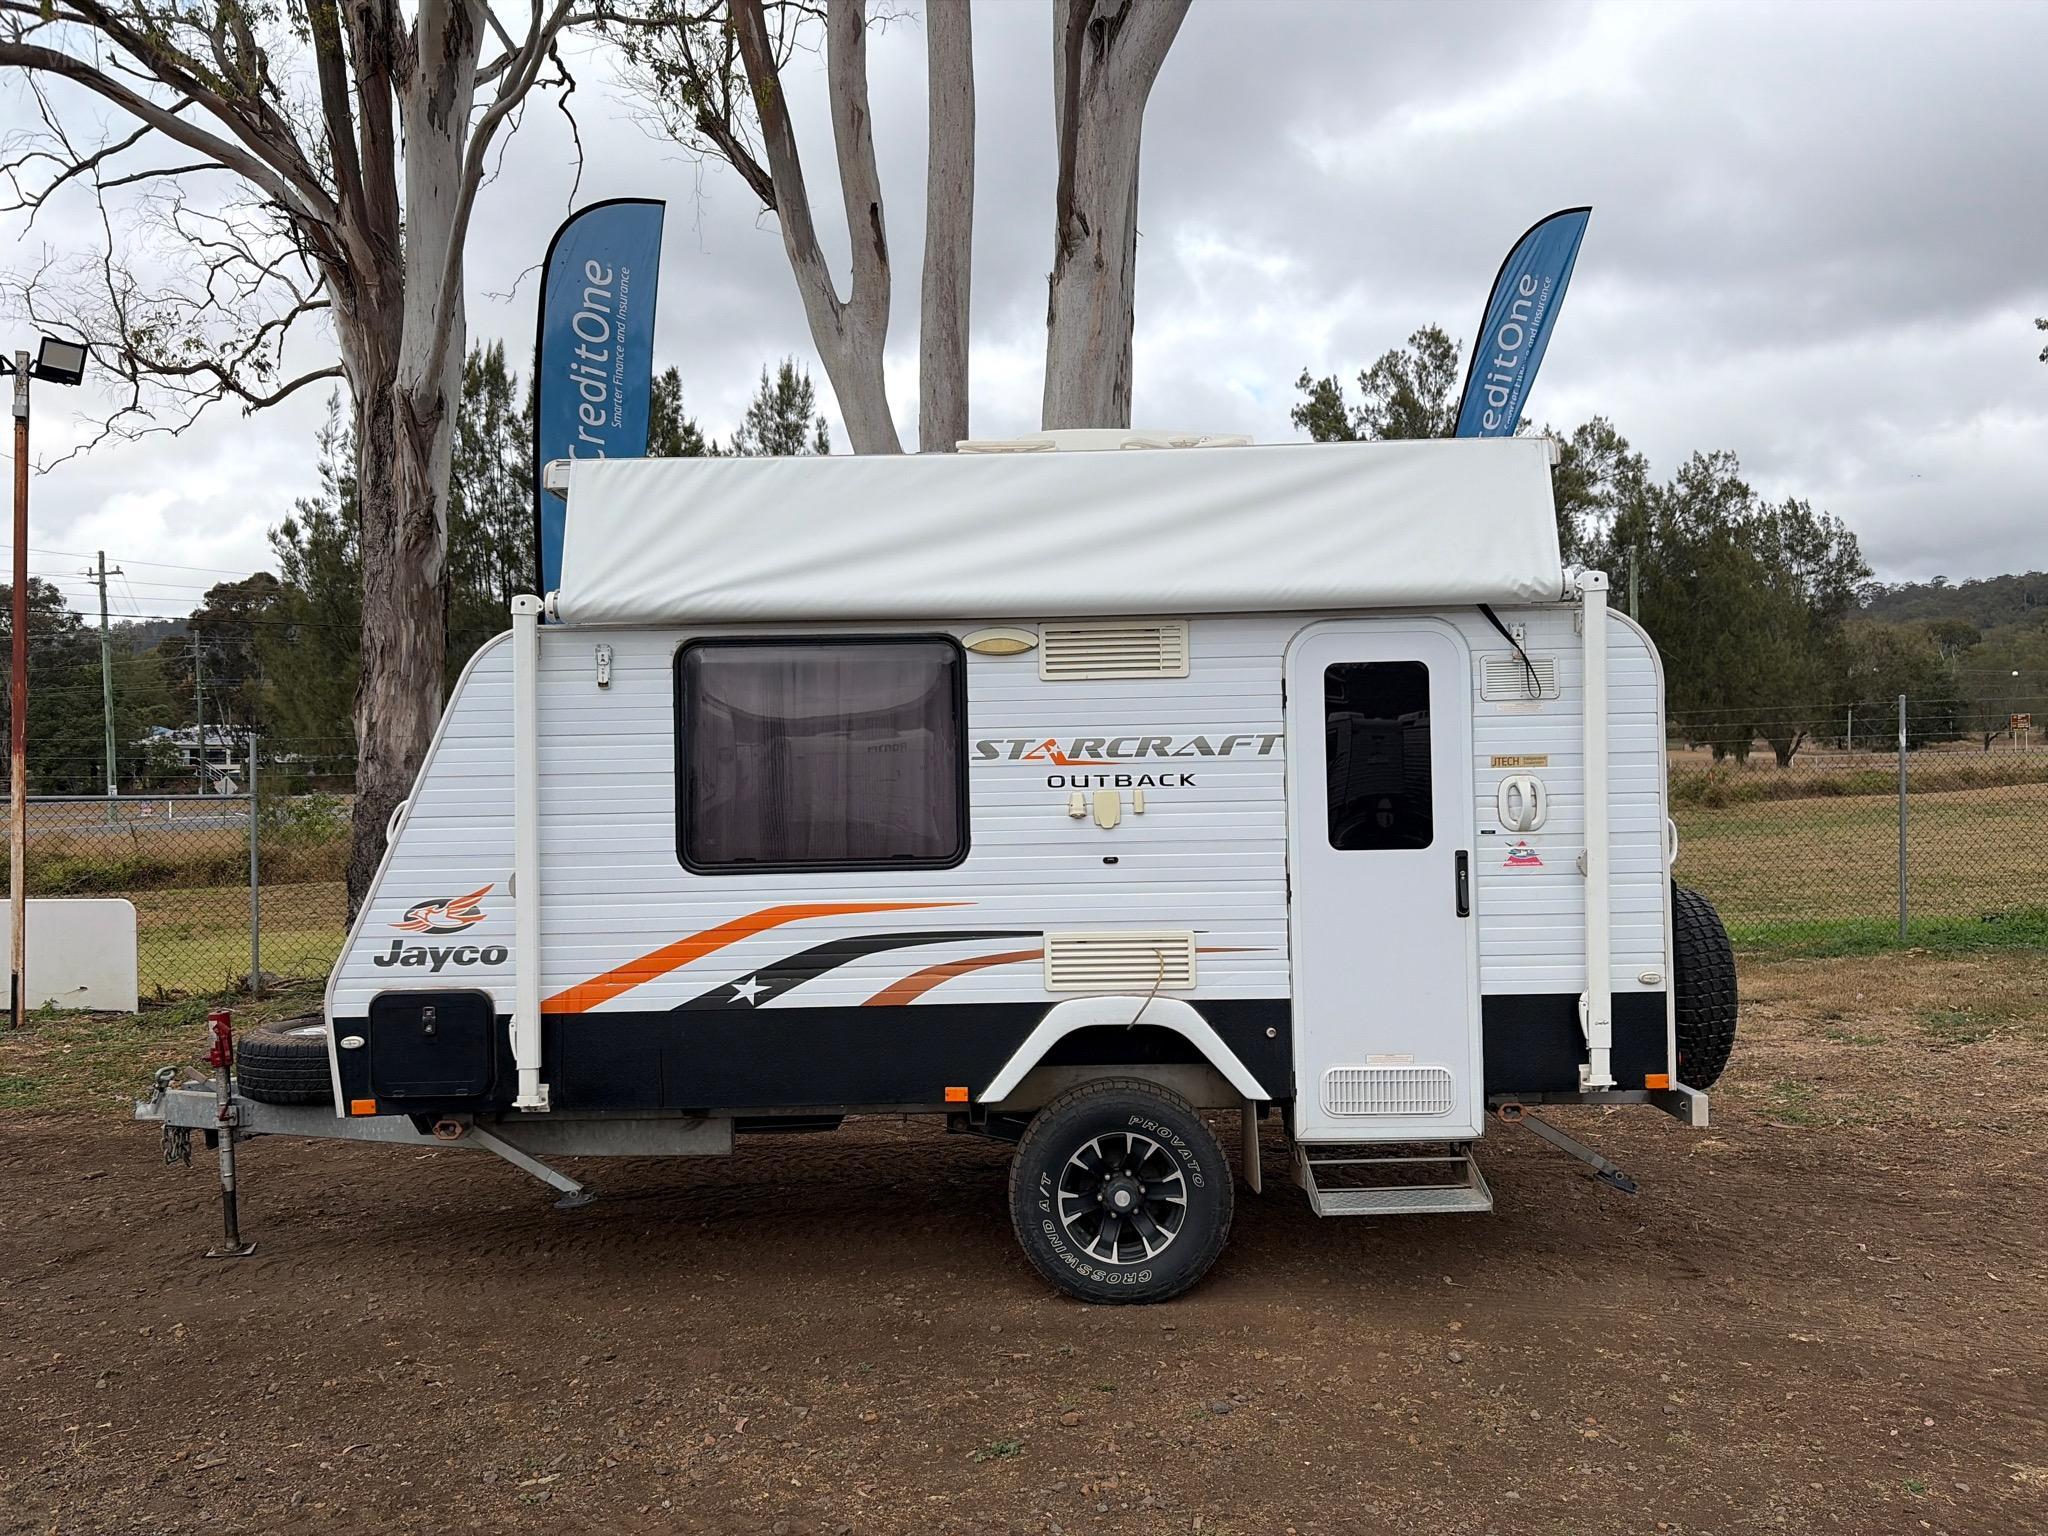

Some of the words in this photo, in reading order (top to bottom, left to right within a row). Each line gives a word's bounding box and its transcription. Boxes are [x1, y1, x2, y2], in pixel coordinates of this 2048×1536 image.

[617, 266, 631, 320] Insurance
[1531, 276, 1552, 326] Insurance
[616, 321, 626, 342] and
[1528, 327, 1538, 348] and
[613, 345, 625, 386] Finance
[1479, 273, 1538, 438] editOne
[611, 389, 623, 428] Smarter
[971, 734, 1285, 765] STARCRAFT
[1491, 756, 1520, 767] JTECH
[1047, 773, 1197, 789] OUTBACK
[373, 939, 509, 972] Jayco
[1128, 1115, 1205, 1188] PROVATO
[1039, 1172, 1052, 1212] A/T
[1042, 1219, 1153, 1284] CROSSWIND
